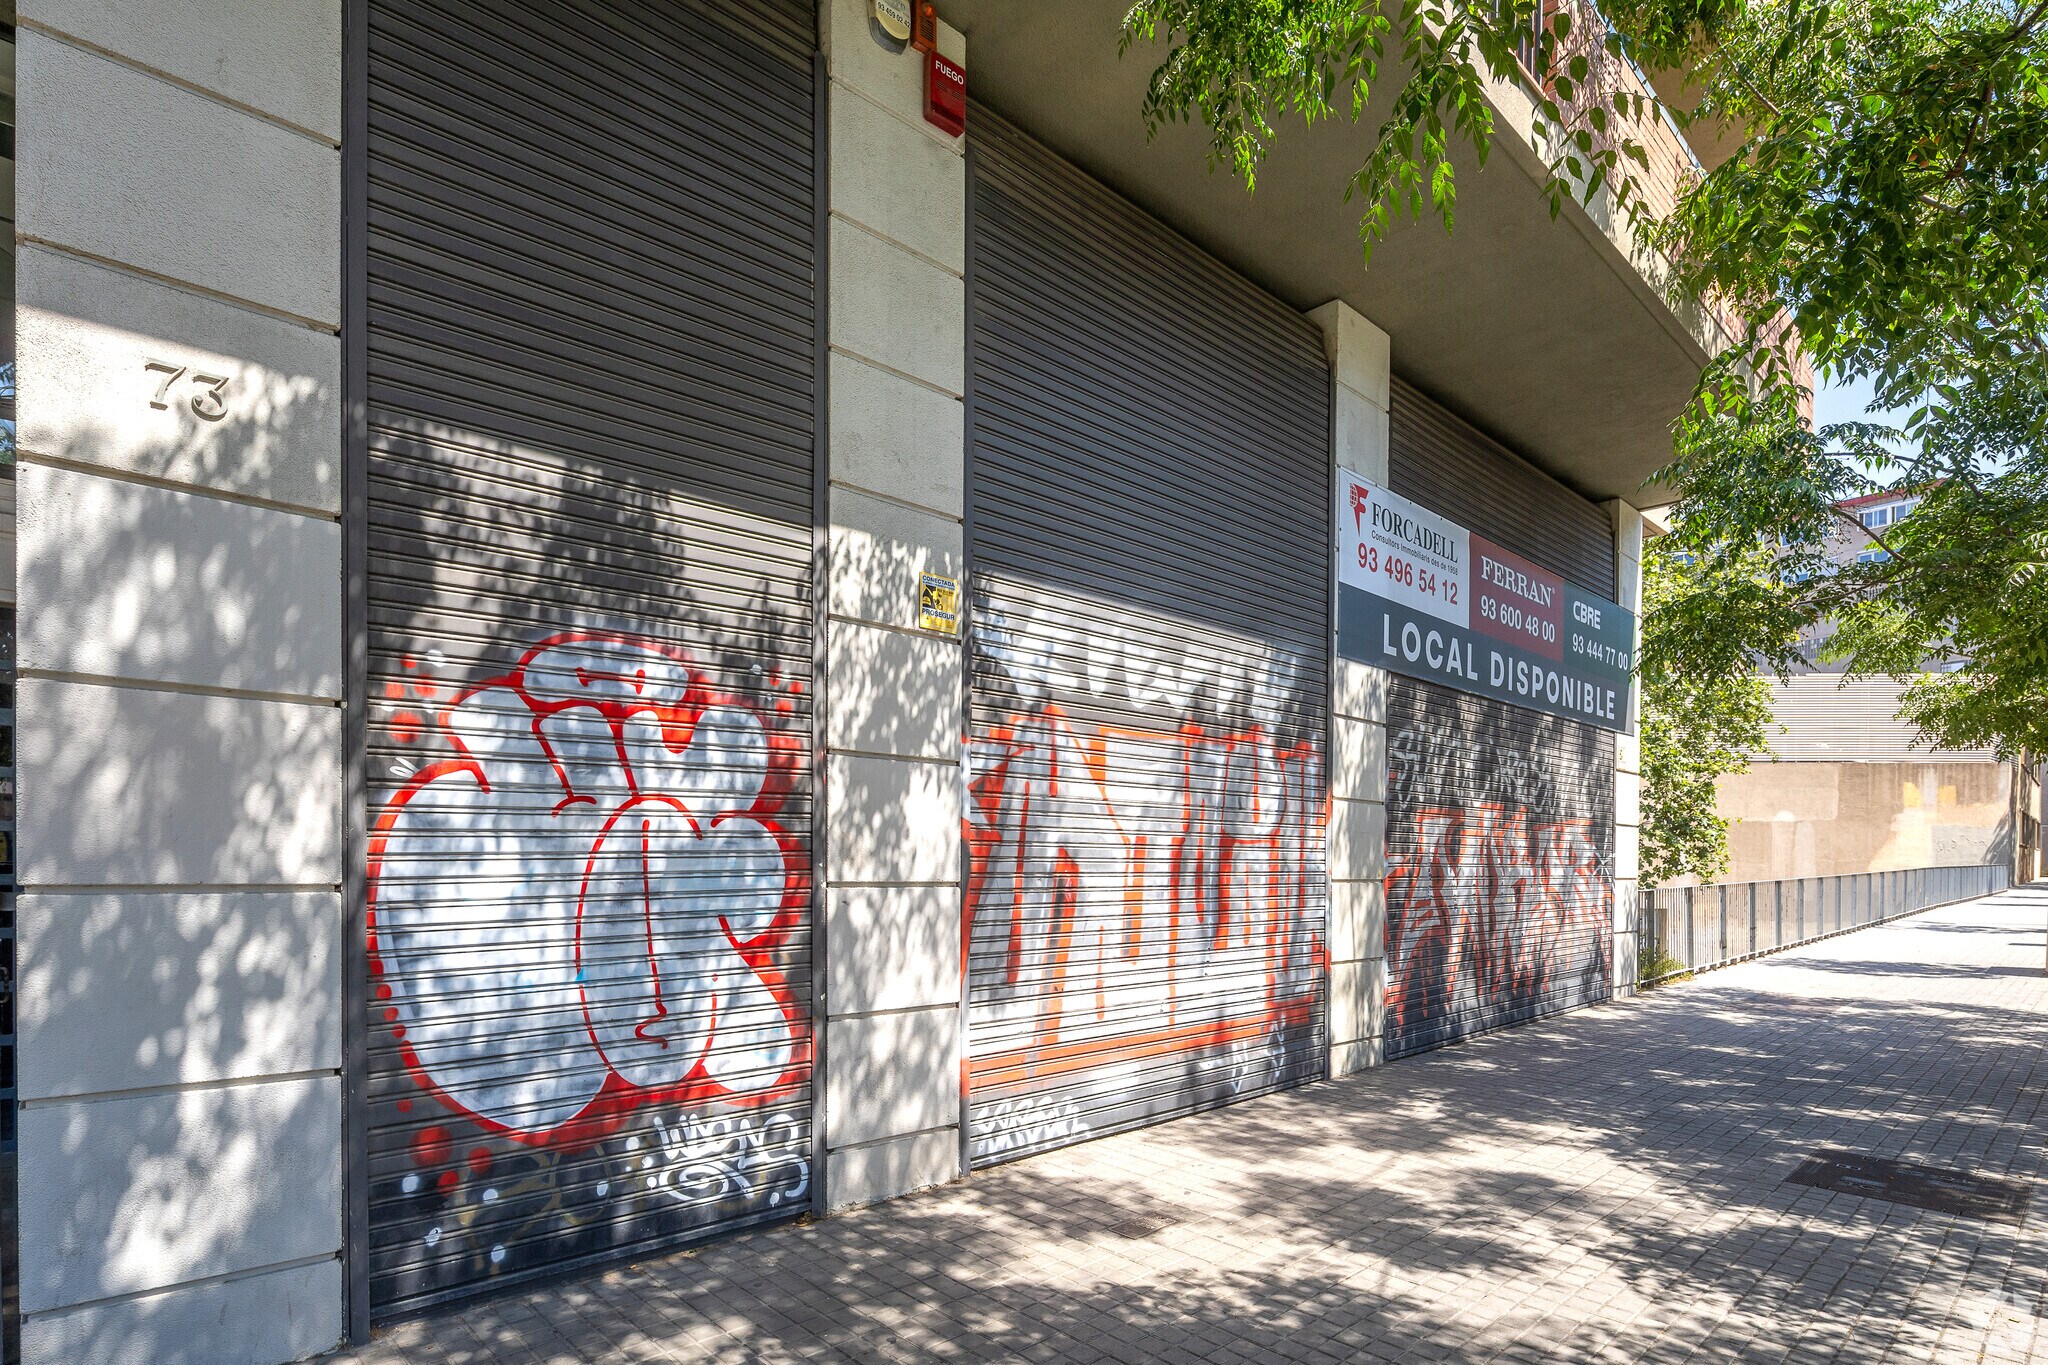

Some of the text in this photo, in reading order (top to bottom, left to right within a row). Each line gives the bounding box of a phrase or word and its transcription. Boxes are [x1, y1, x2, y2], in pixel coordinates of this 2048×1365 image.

[878, 2, 884, 11] 93
[935, 60, 964, 85] FUEGO
[145, 358, 229, 422] 73
[1371, 502, 1458, 563] FORCADELL
[1371, 530, 1458, 576] Consultors Immobiliaris des de 1958
[922, 575, 955, 587] CONECTADA
[1358, 542, 1458, 605] 93 496 54 12
[922, 607, 955, 620] PROSEGUR
[1481, 595, 1555, 643] 93 600 48 00
[1573, 600, 1602, 630] CBRE
[1383, 613, 1616, 720] LOCAL DISPONIBLE
[1572, 633, 1628, 671] 93 444 77 00
